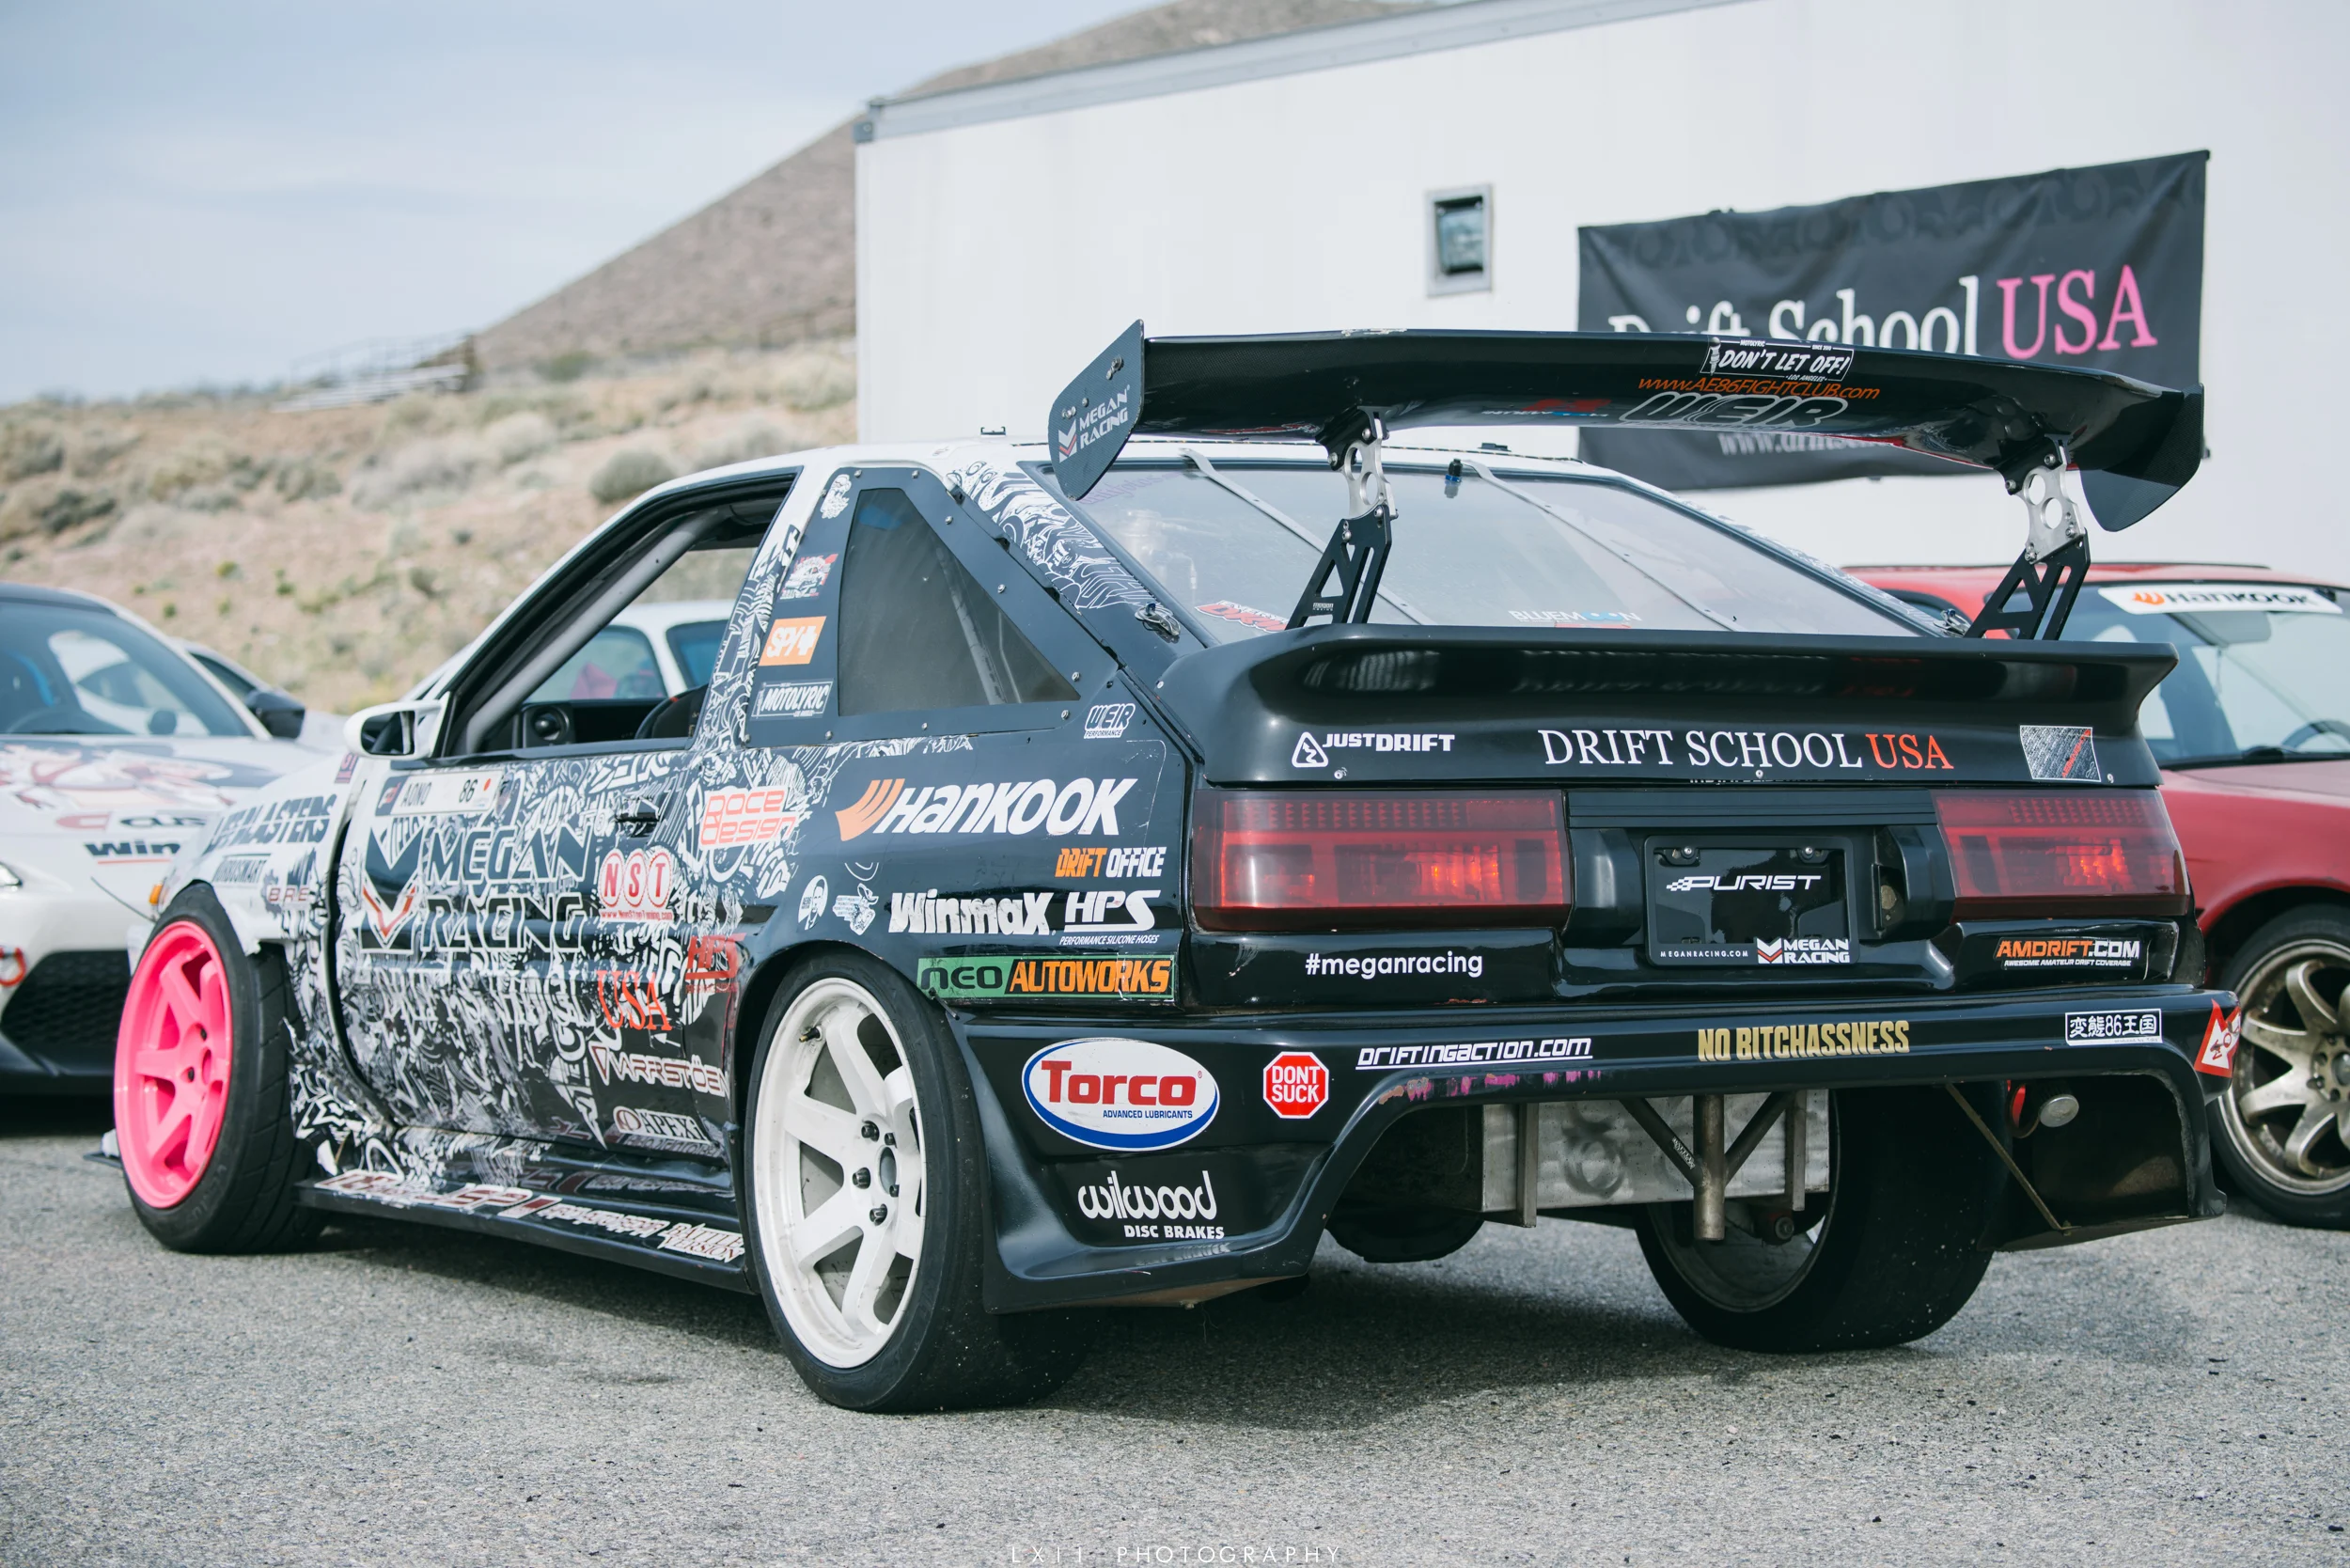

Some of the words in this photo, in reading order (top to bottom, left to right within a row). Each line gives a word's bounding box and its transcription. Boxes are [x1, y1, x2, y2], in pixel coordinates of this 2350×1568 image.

[1996, 263, 2157, 359] USA
[1718, 349, 1777, 370] DON'T
[1775, 353, 1810, 372] LET
[1810, 355, 1850, 375] OFF!
[1638, 377, 1880, 400] www.AE86FIGHTCLUB.com
[1080, 388, 1128, 431] MEGAN
[1080, 407, 1128, 449] RACING
[761, 684, 830, 712] MOTOLYRIC
[1085, 703, 1136, 730] WEIR
[1323, 734, 1455, 752] JUSTDRIFT
[1538, 729, 1673, 765] DRIFT
[1688, 731, 1862, 768] SCHOOL
[1866, 733, 1953, 770] USA
[459, 779, 478, 803] 86
[426, 825, 594, 885] MEGAN
[1055, 848, 1107, 877] DRIFT
[1105, 847, 1167, 877] OFFICE
[603, 863, 666, 897] NST
[1689, 875, 1821, 891] PURIST
[420, 892, 588, 952] RACING
[1064, 890, 1161, 933] HPS
[1059, 936, 1107, 945] PERFORMANCE
[1106, 935, 1139, 944] SILICONE
[1136, 934, 1160, 944] HOSES
[1784, 938, 1849, 950] MEGAN
[1997, 940, 2139, 959] AMDRIFT.COM
[1305, 950, 1482, 980] #meganracing
[1784, 951, 1850, 964] RACING
[1010, 960, 1172, 993] AUTOWORKS
[596, 969, 672, 1031] USA
[2069, 1014, 2157, 1038] 変態86王国
[1698, 1029, 1731, 1061] NO
[1736, 1020, 1910, 1058] BITCHASSNESS
[1042, 1060, 1197, 1105] Torco
[1272, 1066, 1320, 1085] DONT
[1272, 1085, 1319, 1103] SUCK
[1103, 1110, 1143, 1119] ADVANCED
[1145, 1110, 1193, 1119] LUBRICANTS
[1078, 1170, 1217, 1220] wilwood
[1124, 1225, 1159, 1238] DISC
[1165, 1226, 1224, 1239] BRAKES
